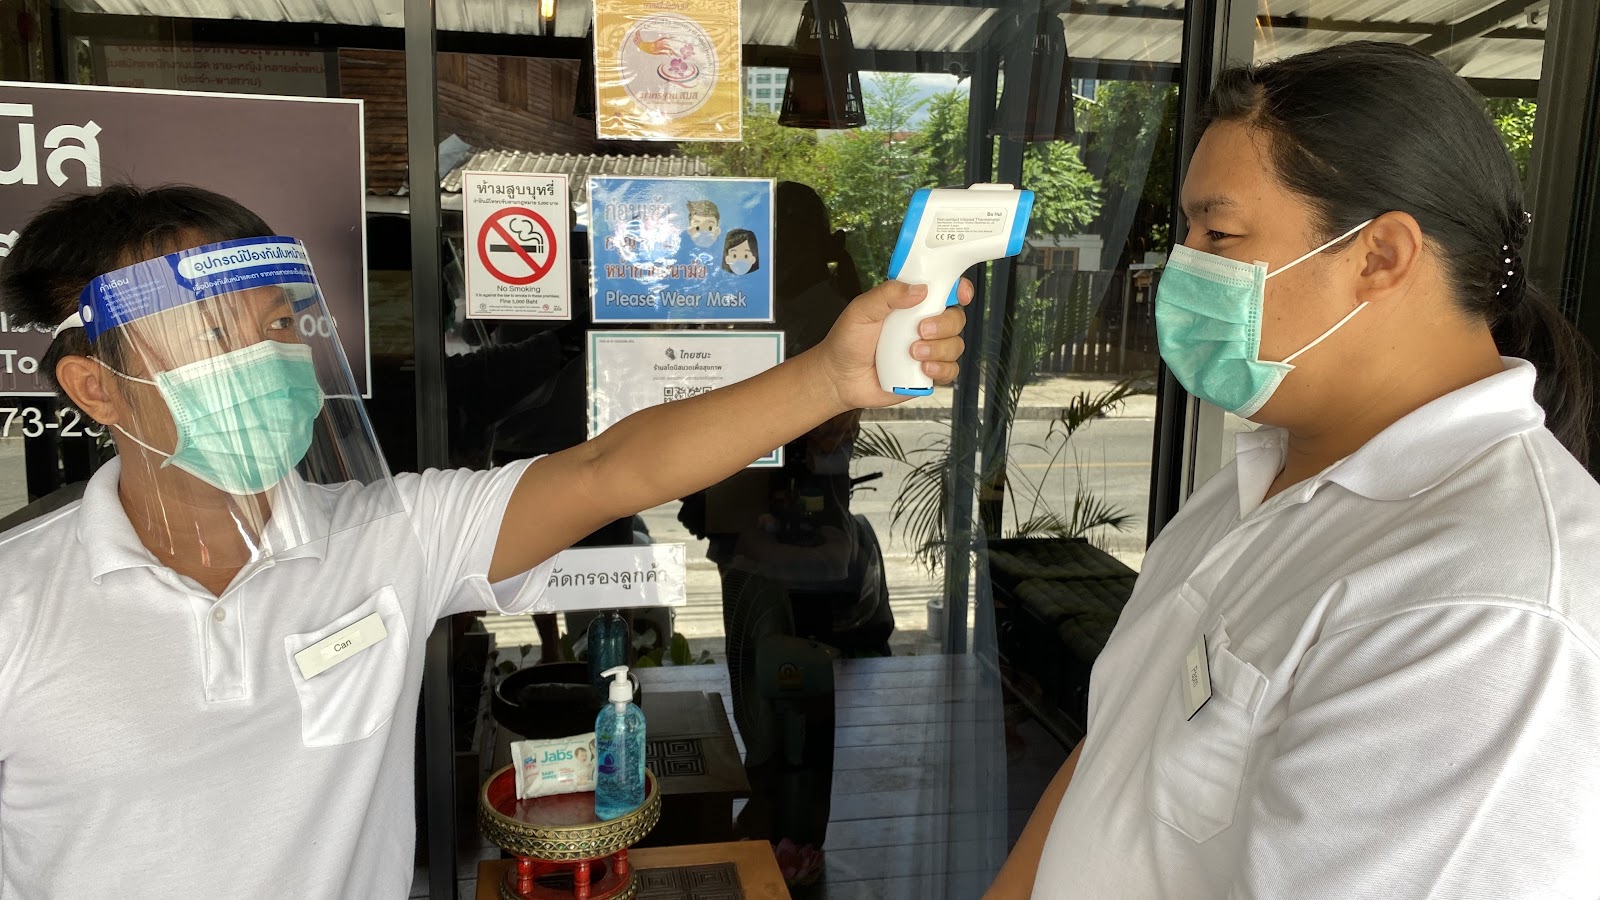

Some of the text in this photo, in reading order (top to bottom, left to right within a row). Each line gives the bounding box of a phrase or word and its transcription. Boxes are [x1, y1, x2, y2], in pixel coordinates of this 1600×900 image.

[476, 179, 554, 200] ห้ามสูบบุหรี่
[509, 285, 541, 294] Smoking
[605, 290, 748, 307] Please Wear Mask
[680, 349, 712, 360] ไทยชนะ
[333, 639, 352, 652] Can
[540, 749, 573, 763] Jabs
